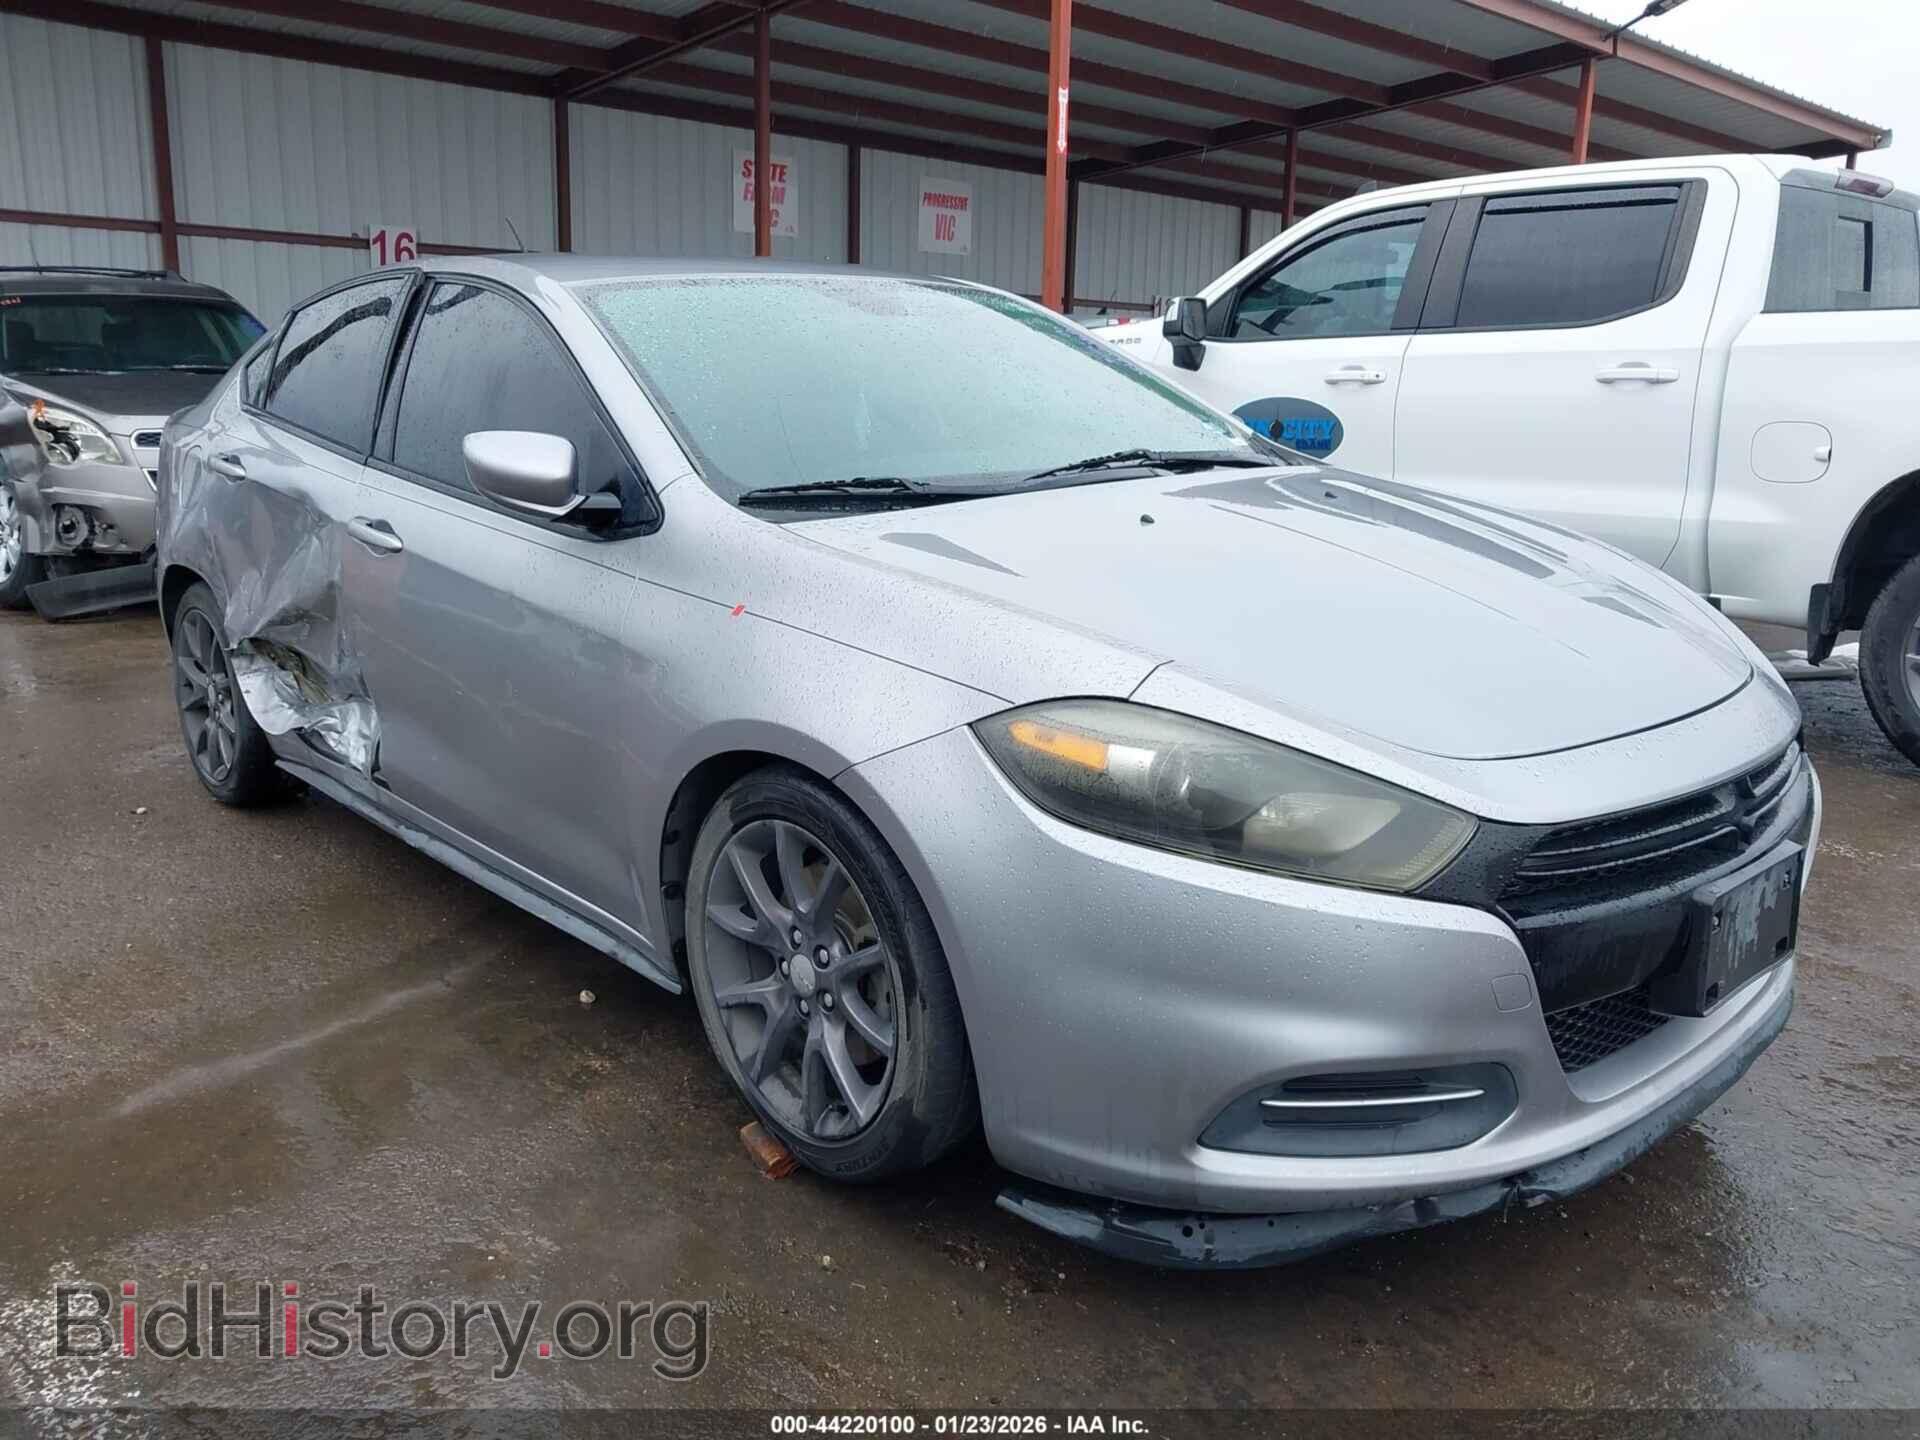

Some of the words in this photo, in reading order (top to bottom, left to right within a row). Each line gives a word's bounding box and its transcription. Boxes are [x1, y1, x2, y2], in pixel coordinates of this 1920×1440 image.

[742, 159, 787, 183] STE
[935, 213, 956, 242] VIC
[371, 230, 415, 266] 16
[1283, 418, 1337, 440] CITY
